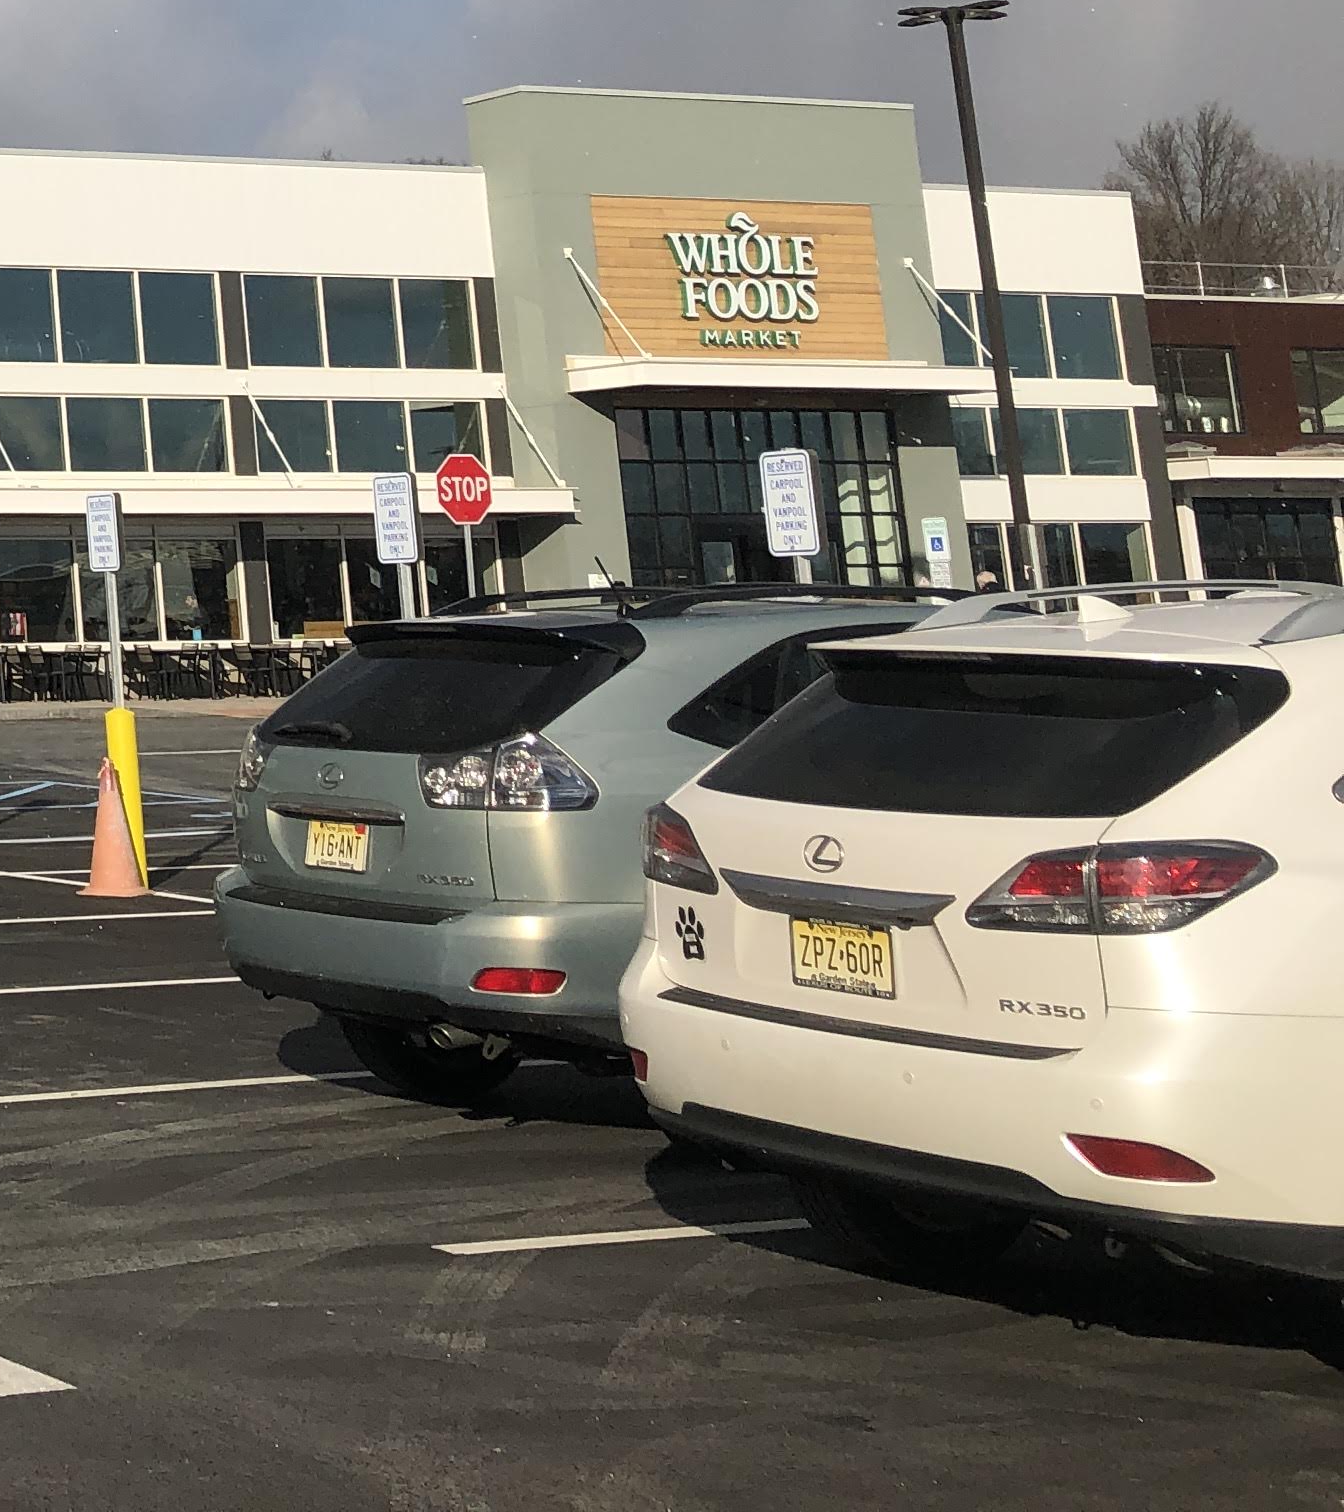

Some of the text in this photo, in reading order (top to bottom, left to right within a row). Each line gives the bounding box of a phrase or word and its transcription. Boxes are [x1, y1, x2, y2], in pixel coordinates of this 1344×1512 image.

[665, 226, 819, 277] WHOLE
[681, 277, 820, 322] FOODS
[701, 329, 801, 349] MARKET
[766, 460, 804, 473] RESERVED
[377, 481, 406, 492] RESERVED
[440, 475, 488, 502] STOP
[770, 478, 804, 490] CARPOOL
[379, 496, 406, 507] CARPOOL
[781, 492, 796, 503] AND
[388, 508, 400, 518] AND
[773, 506, 807, 518] VANPOOL
[776, 519, 808, 531] PARKING
[783, 535, 802, 545] ONLY
[816, 924, 867, 940] New Jersey
[818, 972, 847, 985] Garden
